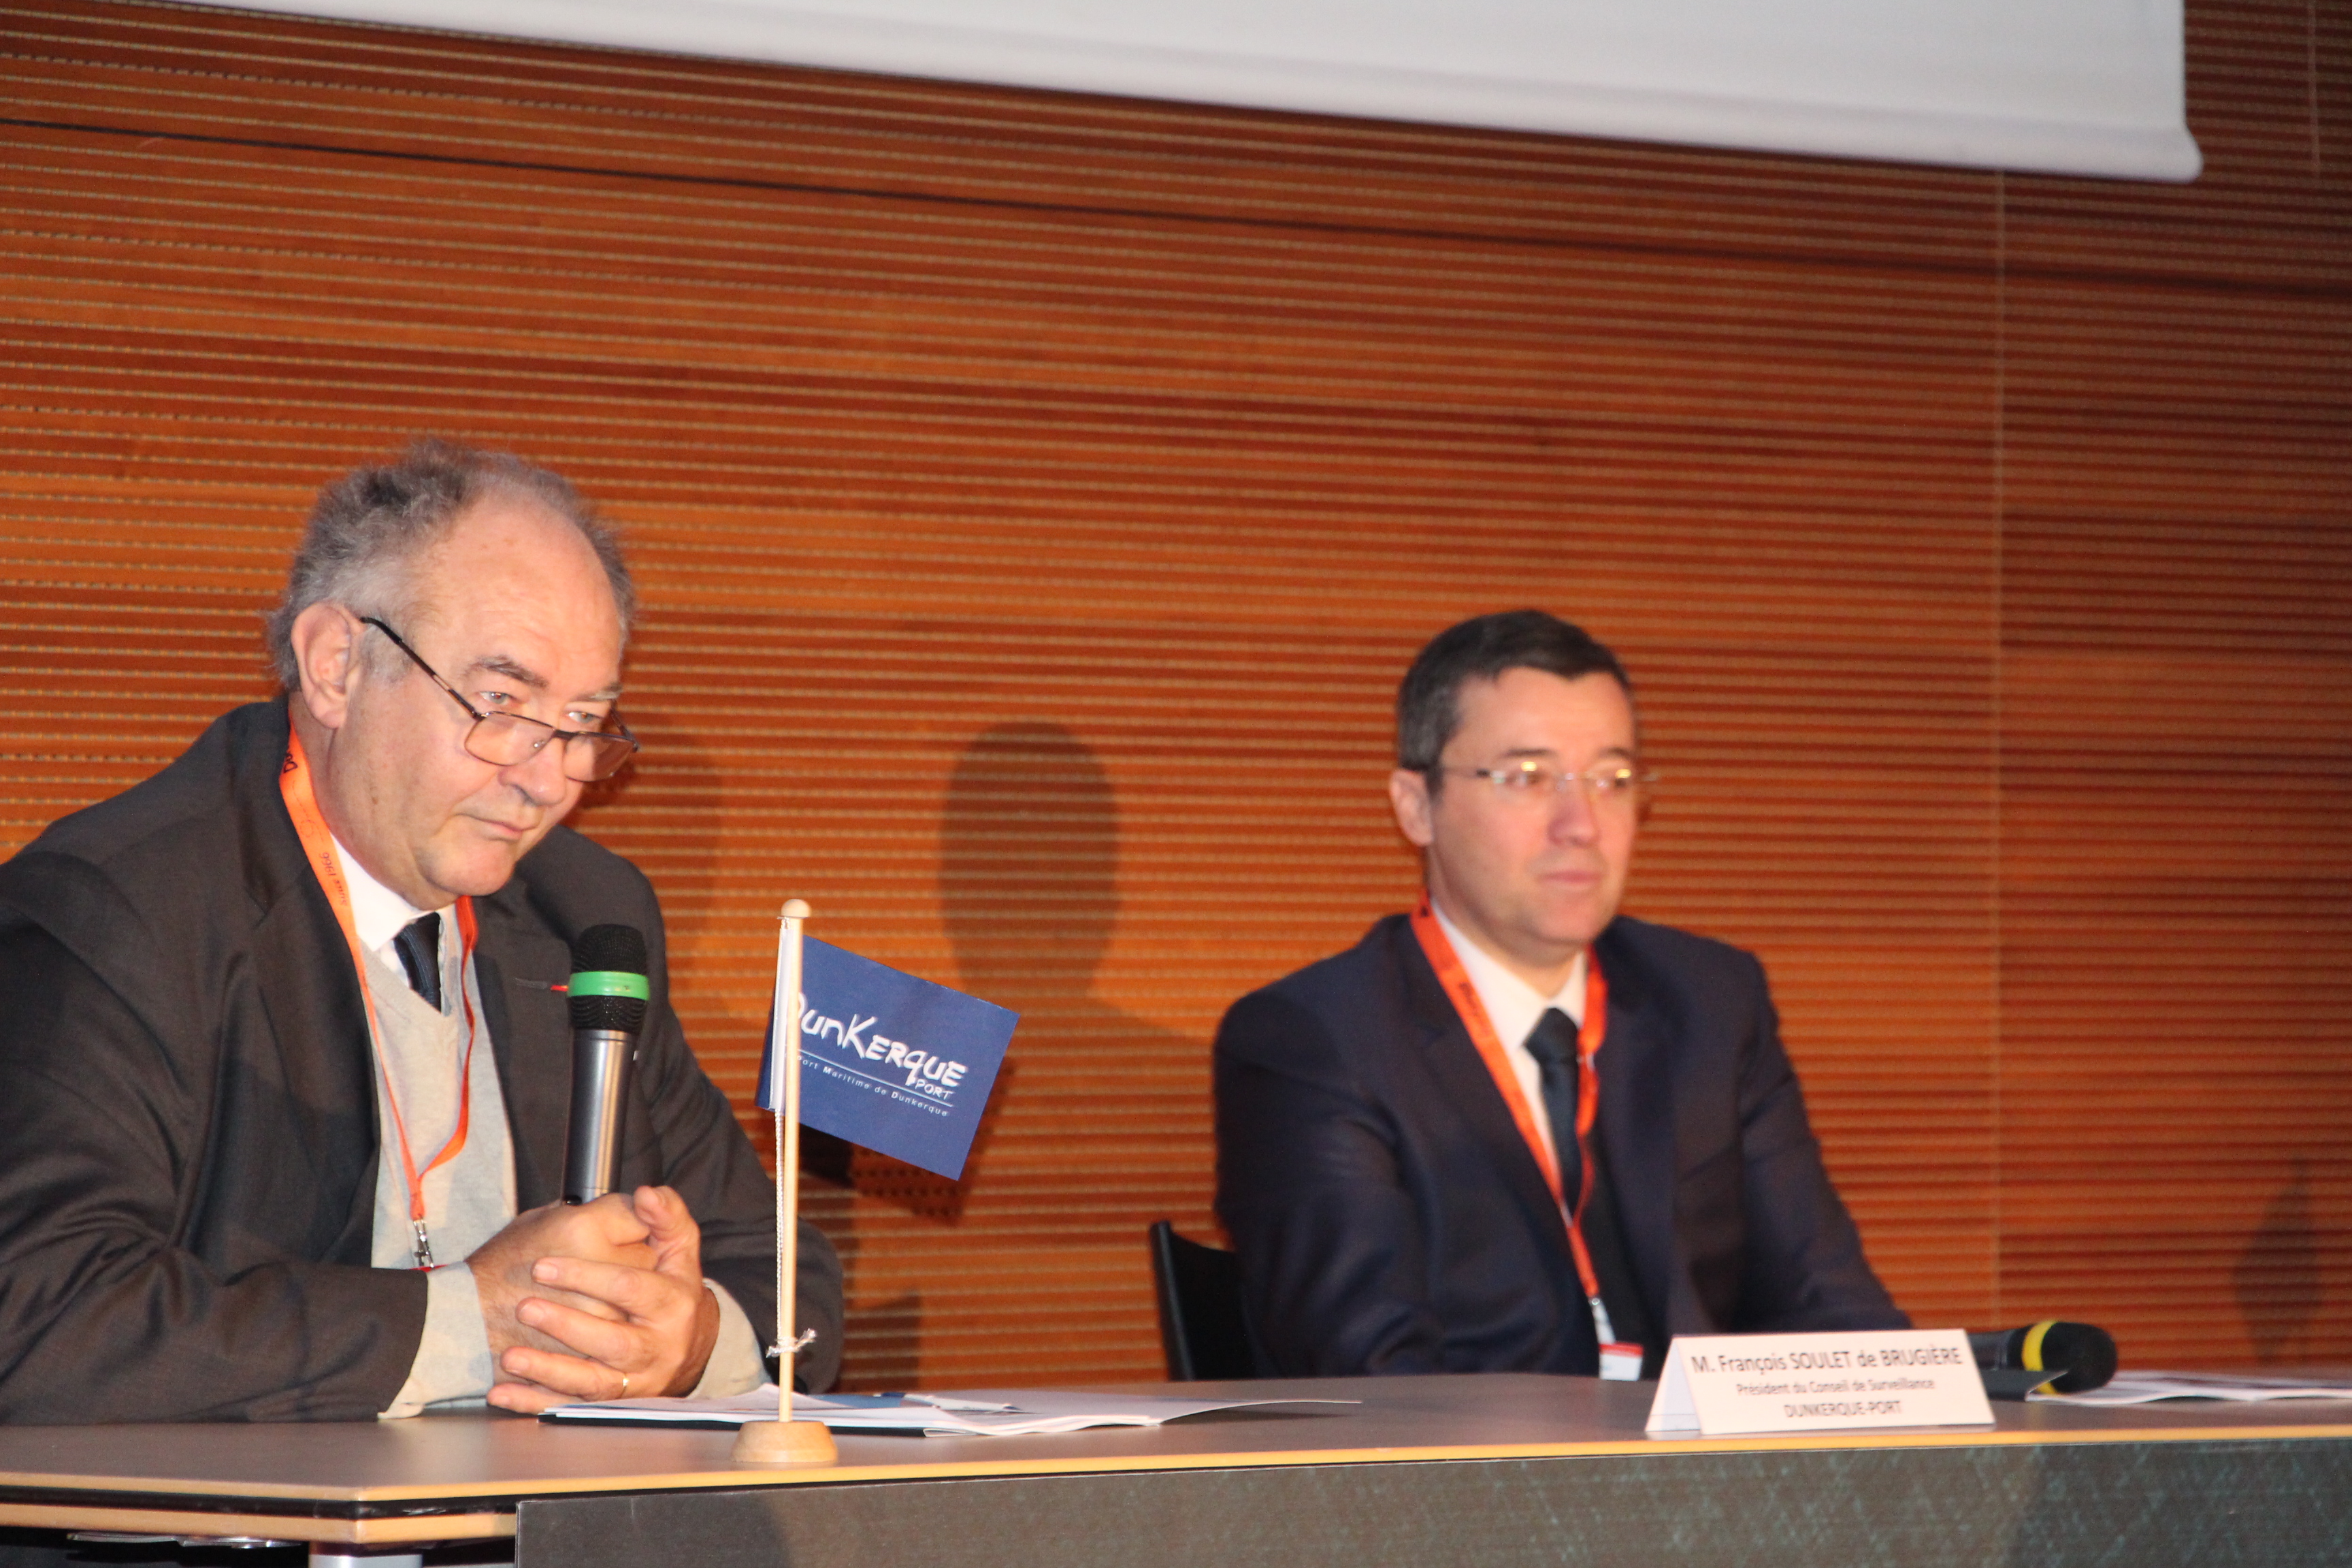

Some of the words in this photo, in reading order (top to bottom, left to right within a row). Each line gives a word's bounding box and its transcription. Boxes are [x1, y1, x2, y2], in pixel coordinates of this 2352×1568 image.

[321, 852, 336, 876] 1966
[823, 1066, 870, 1090] Maritime
[875, 1085, 887, 1096] de
[891, 1092, 948, 1117] Dunkerque
[914, 1080, 956, 1100] PORT
[1691, 1356, 1715, 1373] M.
[1718, 1354, 1786, 1376] François
[1789, 1351, 1850, 1370] SOULET
[1857, 1349, 1877, 1368] de
[1881, 1343, 1963, 1367] BRUGIÈRE
[1737, 1384, 1790, 1396] Président
[1794, 1382, 1807, 1394] du
[1810, 1379, 1848, 1394] Conseil
[1852, 1379, 1866, 1392] de
[1868, 1377, 1936, 1392] Surveillance
[1784, 1400, 1904, 1418] DUNKERQUE-PORT
